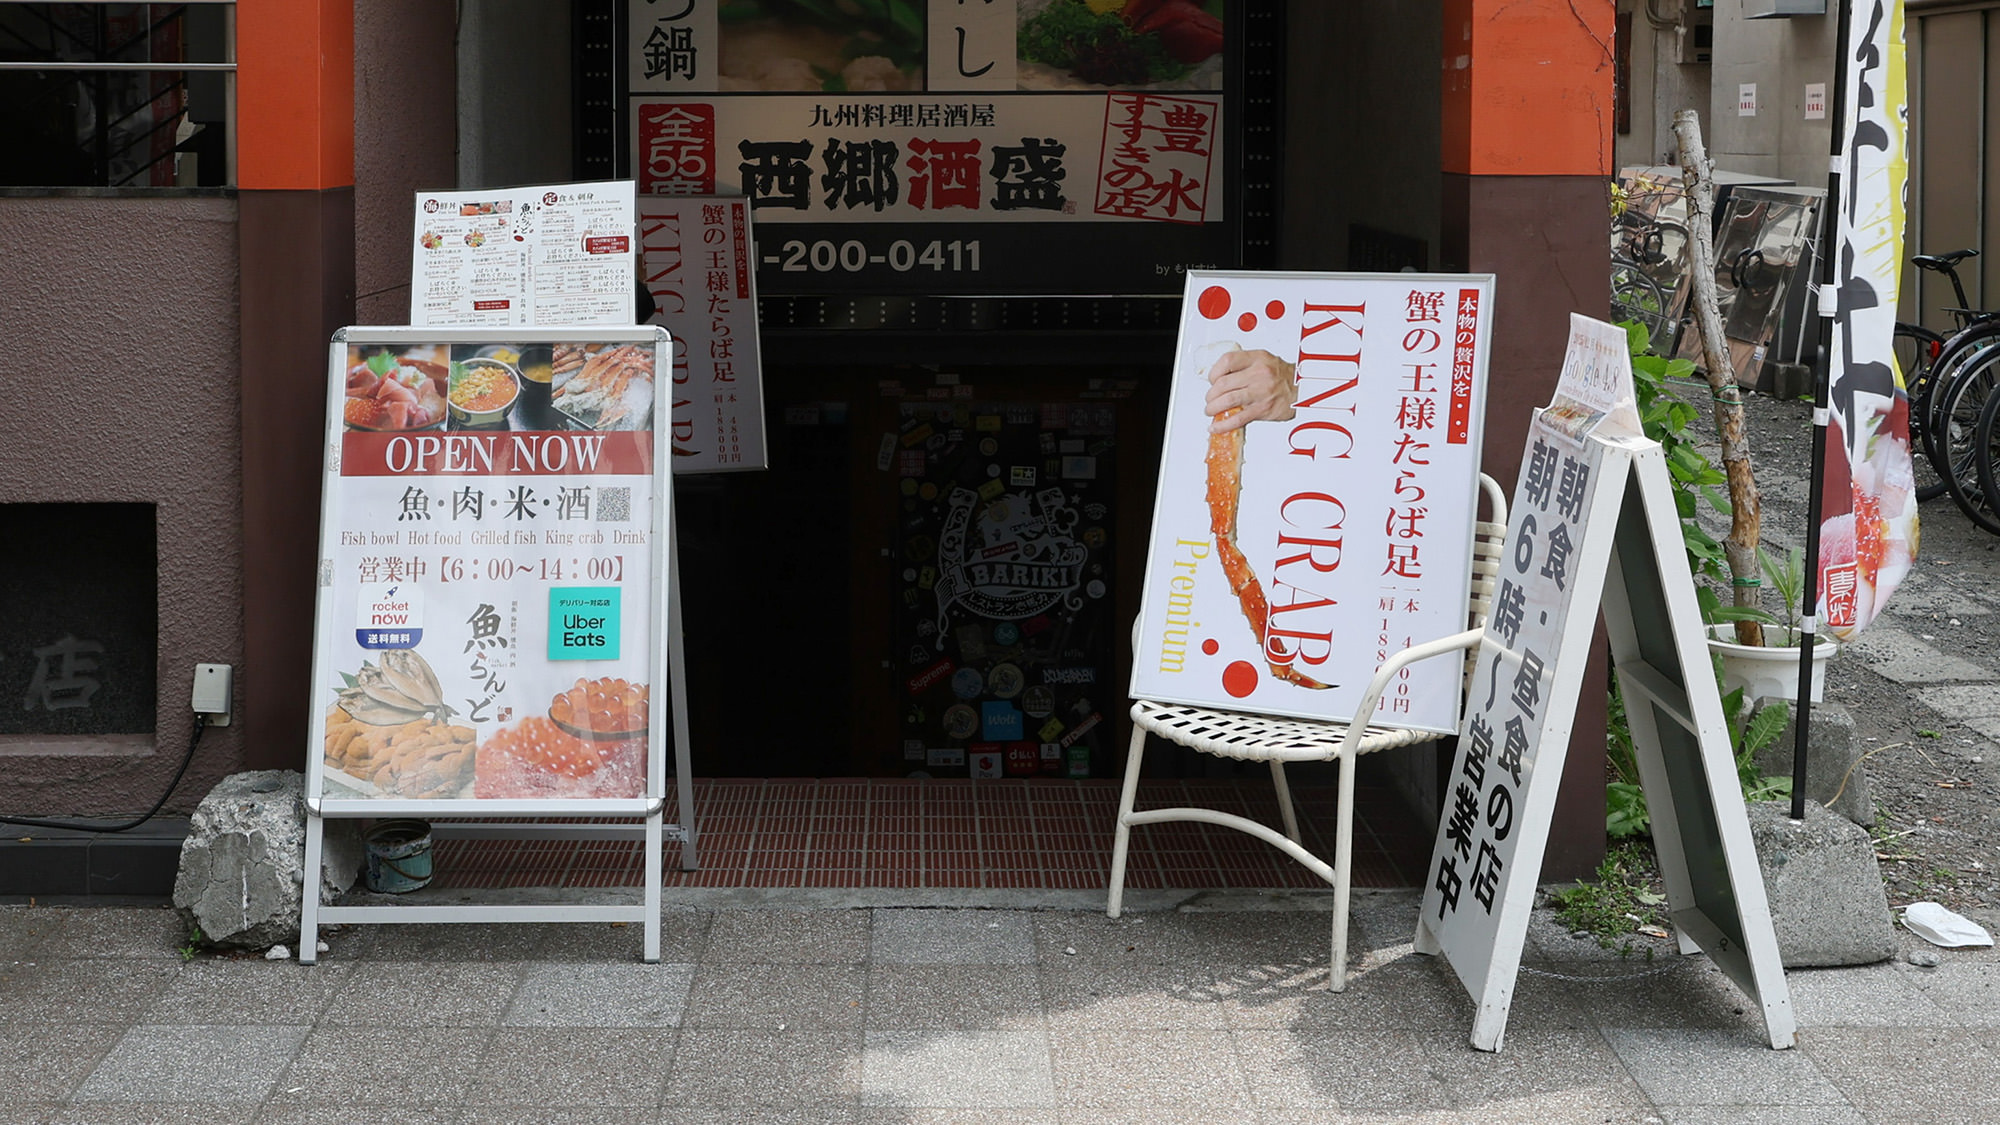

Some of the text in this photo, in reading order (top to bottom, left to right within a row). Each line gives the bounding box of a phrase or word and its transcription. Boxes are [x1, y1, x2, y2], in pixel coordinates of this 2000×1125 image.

[955, 0, 996, 78] し
[808, 104, 995, 128] 九州料理居酒屋
[738, 137, 1067, 212] 西郷酒盛
[1096, 95, 1162, 217] すすきの店
[1147, 104, 1209, 217] 豊水
[641, 213, 686, 316] KING
[756, 239, 981, 272] -200-0411
[1155, 264, 1170, 276] by
[702, 203, 736, 383] 蟹の王様たらば足
[1287, 298, 1367, 462] KING
[1565, 350, 1600, 388] Google
[1381, 289, 1446, 579] 蟹の王様たらば足
[385, 435, 606, 473] OPEN NOW
[398, 485, 591, 522] 魚・肉・米・酒
[341, 530, 646, 546] Fish bowl Hot food Grilled fish King crab Drink
[971, 563, 1069, 588] BARIKI
[1265, 491, 1348, 667] CRAB
[372, 601, 409, 611] rocket
[559, 599, 611, 607] デリバリー対応店
[1159, 536, 1211, 674] Premium
[1378, 585, 1396, 611] 一肩
[371, 613, 409, 625] now
[564, 614, 606, 629] Uber
[367, 633, 411, 644] 送料無料
[563, 632, 606, 647] Eats
[1393, 587, 1421, 714] 一本 400円
[463, 603, 508, 723] 魚らんど
[910, 661, 951, 691] Supreme
[1470, 456, 1590, 916] 朝食・昼食の店
[988, 714, 1017, 726] Wolt
